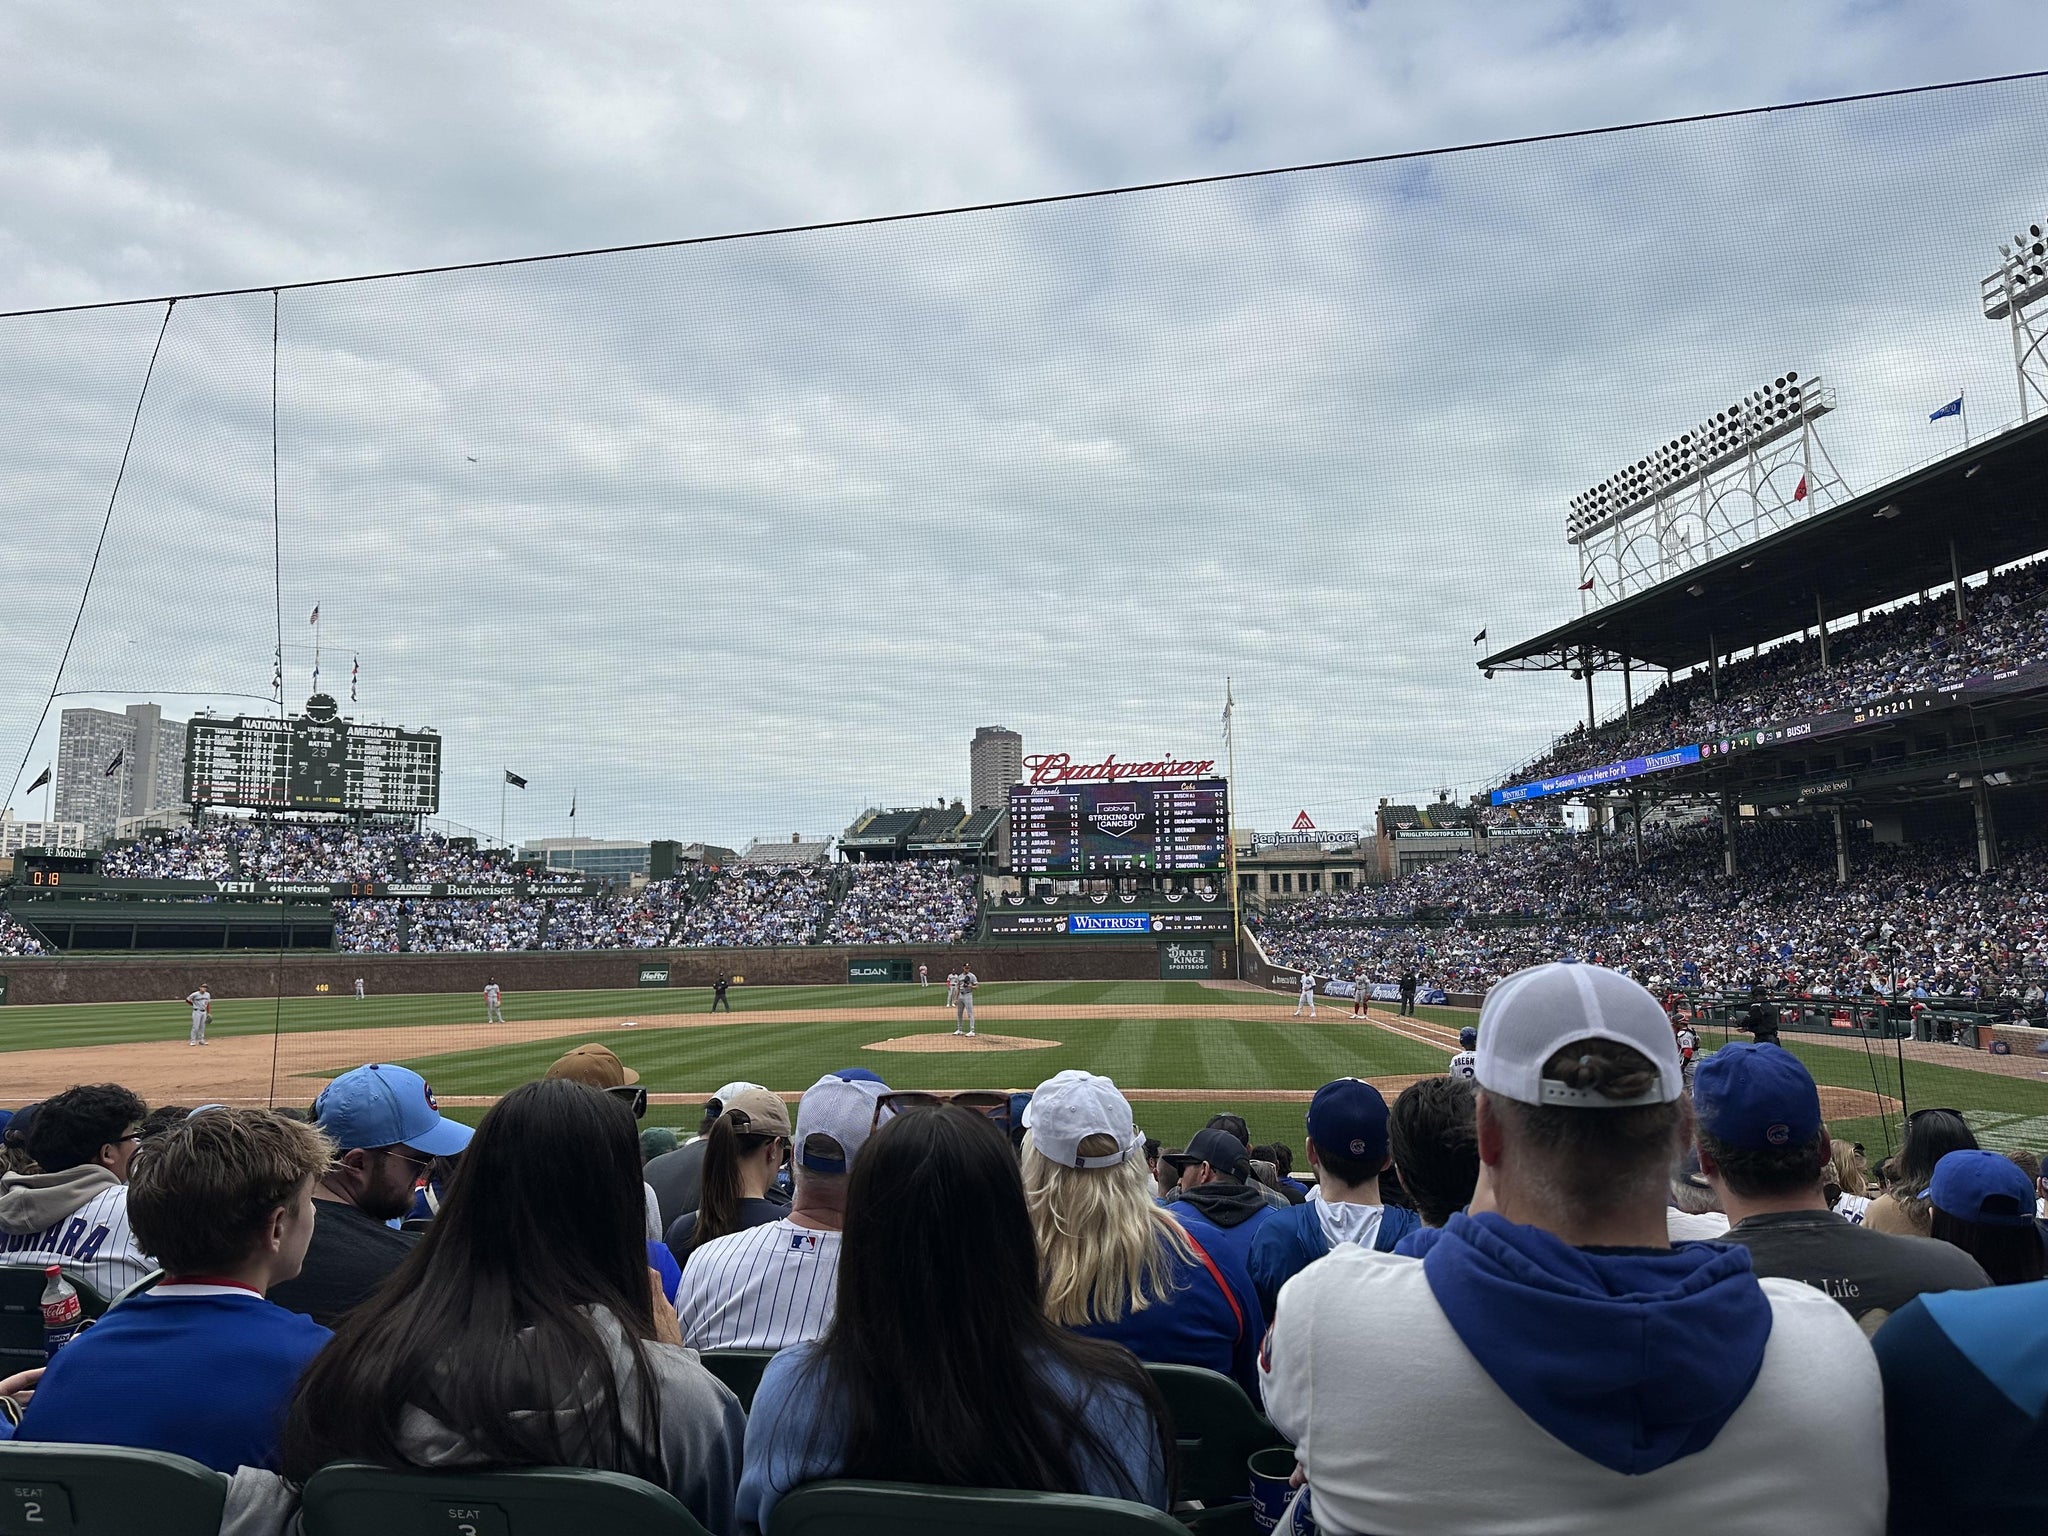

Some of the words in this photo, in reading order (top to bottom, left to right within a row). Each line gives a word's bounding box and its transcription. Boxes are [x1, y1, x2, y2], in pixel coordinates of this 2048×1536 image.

[1993, 672, 2006, 681] PITCH
[2007, 669, 2019, 678] TYPE
[1869, 708, 1874, 717] B
[1876, 706, 1882, 717] 2
[1884, 705, 1890, 714] S
[1891, 702, 1898, 713] 2
[1907, 698, 1913, 710] 1
[242, 719, 294, 731] NATIONAL
[307, 726, 335, 734] UMPIRES
[346, 726, 396, 738] AMERICAN
[308, 740, 332, 748] BATTER
[1712, 745, 1717, 754] 3
[1731, 740, 1736, 750] 2
[1786, 723, 1811, 738] BUSCH
[311, 748, 328, 758] 29
[1645, 753, 1682, 768] WINTRUST
[299, 766, 307, 775] 2
[329, 767, 338, 777] 2
[1023, 753, 1214, 785] Budweiser
[1542, 783, 1555, 791] New
[1555, 778, 1577, 789] Season,
[1577, 773, 1593, 783] We're
[1593, 770, 1608, 779] Here
[1609, 767, 1620, 777] For
[1620, 765, 1627, 774] It
[1030, 787, 1060, 795] Nationals
[1816, 783, 1832, 793] suite
[1832, 779, 1848, 790] level
[1502, 788, 1527, 799] WINTRUST
[1251, 831, 1310, 846] Benjamin
[1315, 831, 1358, 843] Moore
[1399, 830, 1470, 838] WRIGLEYROOFTOPS.COM
[55, 848, 87, 858] Mobile
[1089, 861, 1096, 870] 3
[1104, 861, 1109, 870] 1
[1124, 860, 1131, 869] 2
[1139, 860, 1146, 869] 4
[33, 871, 59, 886] 0:18
[215, 881, 255, 893] YETI
[277, 883, 331, 895] tastytrade
[387, 884, 433, 892] GRAINGER
[447, 884, 513, 895] Budweiser
[540, 884, 584, 894] Advocate
[1075, 916, 1144, 929] WINTRUST
[1169, 949, 1206, 958] DRAFT
[1173, 956, 1205, 964] KINGS
[642, 971, 666, 981] Hefty
[1820, 1278, 1860, 1298] Life
[14, 1487, 43, 1498] SEAT
[23, 1501, 44, 1522] 2
[448, 1508, 480, 1519] SEAT
